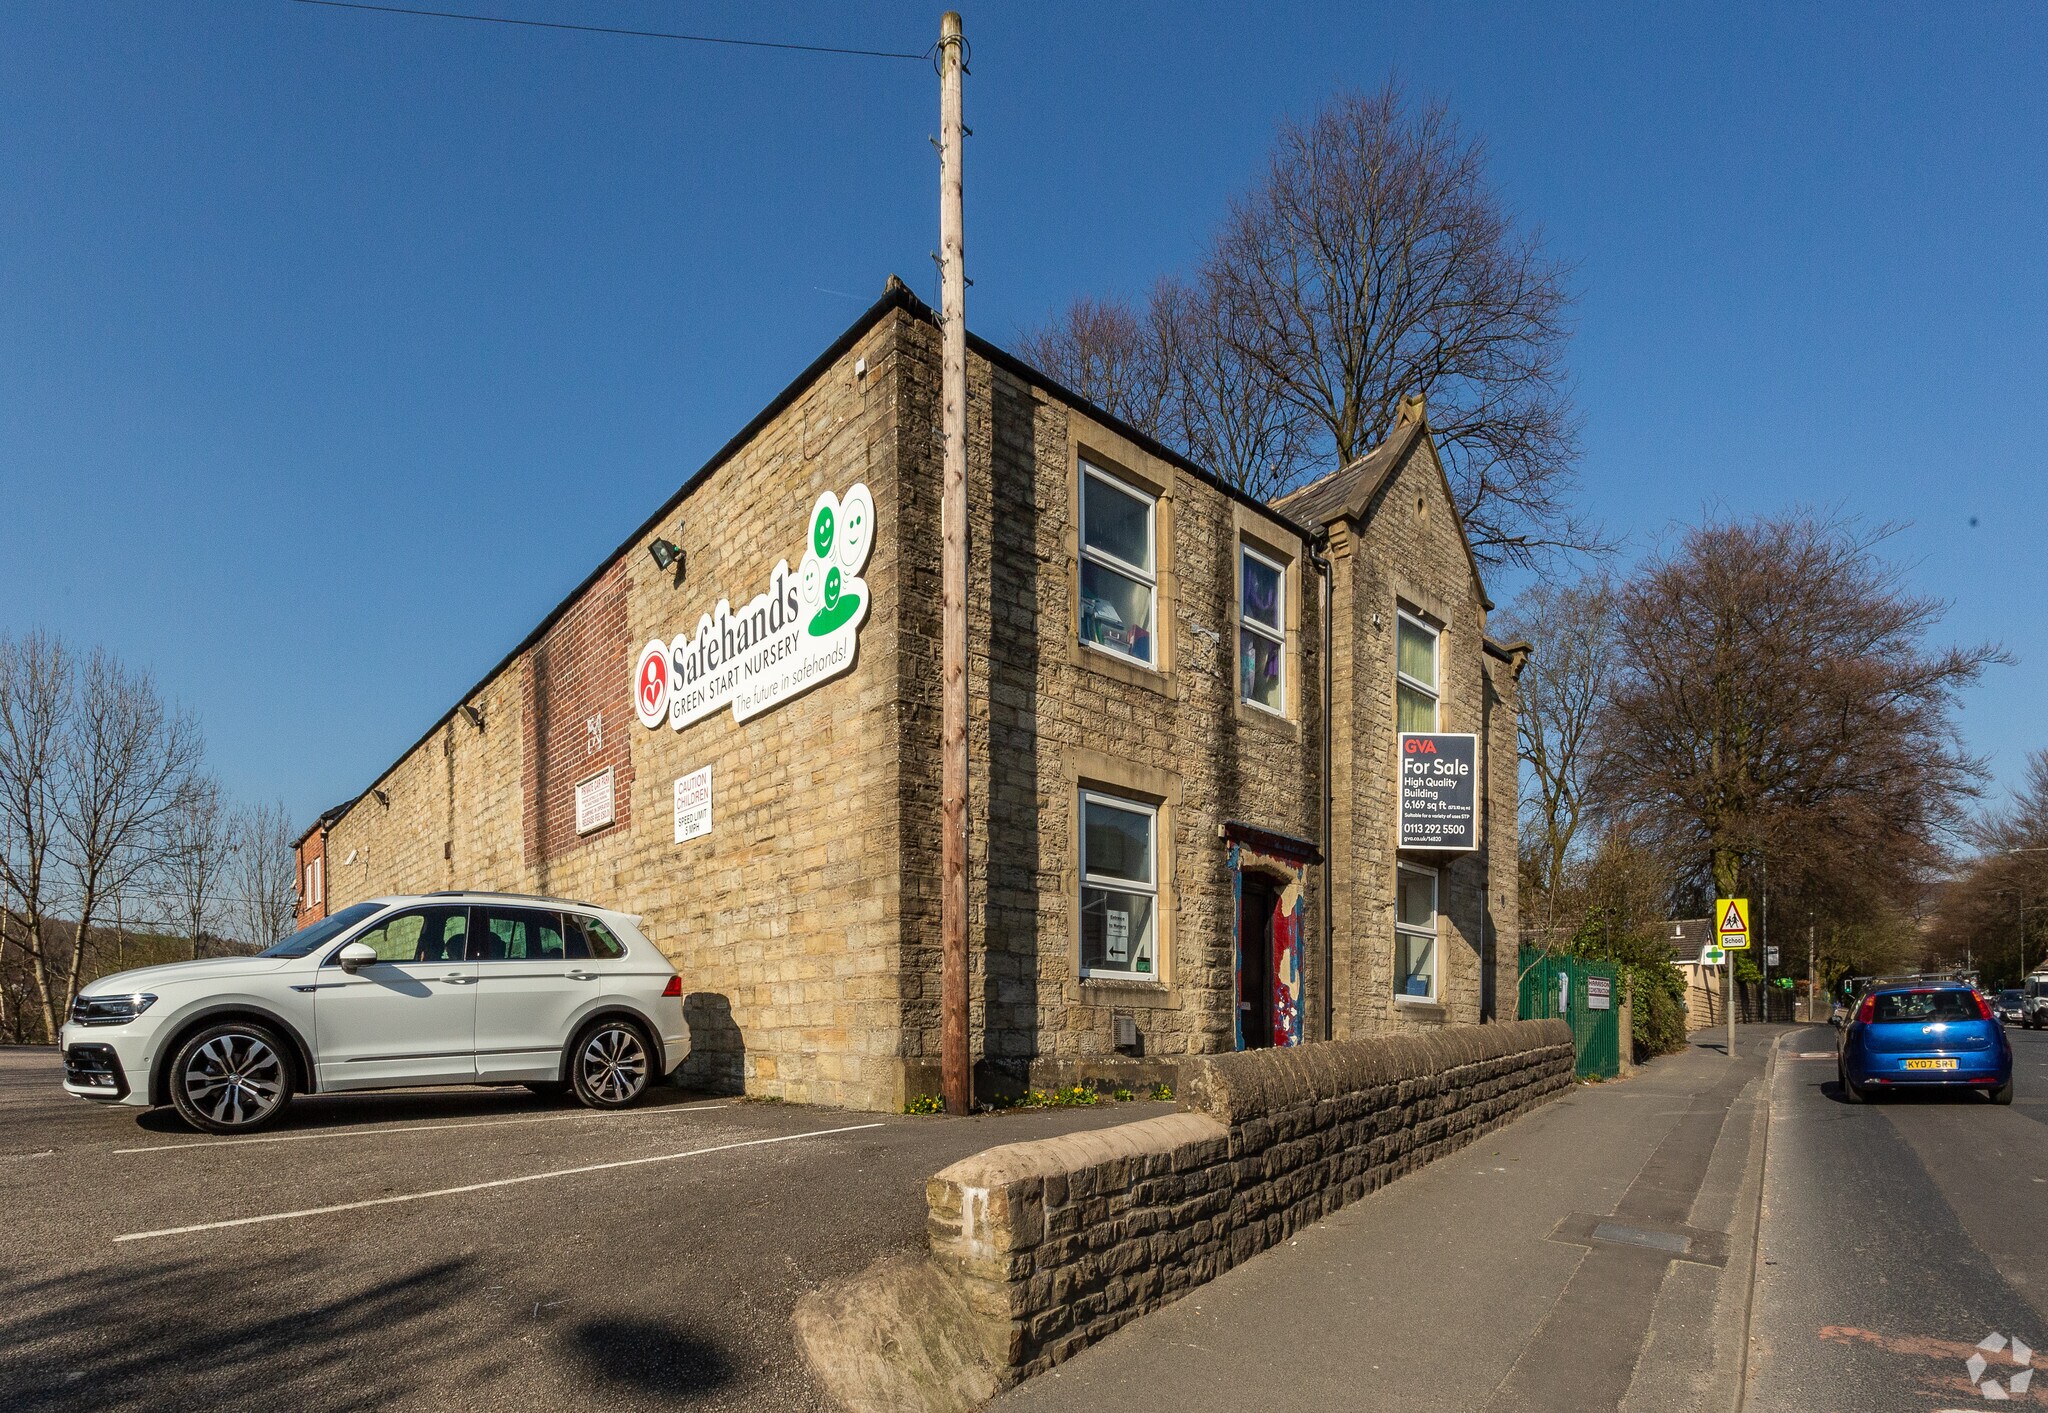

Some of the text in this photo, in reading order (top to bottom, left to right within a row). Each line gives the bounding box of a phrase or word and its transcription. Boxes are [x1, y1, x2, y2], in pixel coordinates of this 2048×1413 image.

[673, 574, 799, 691] Safehands
[673, 630, 800, 719] GREEN START NURSERY
[736, 637, 847, 713] The future in safehands!
[1405, 739, 1437, 754] GVA
[1404, 758, 1469, 775] For Sale
[678, 772, 706, 795] CAUTION
[1404, 777, 1457, 789] High Quality
[676, 787, 709, 810] CHILDREN
[1404, 789, 1438, 800] Building
[1404, 800, 1425, 810] 6,169
[1427, 802, 1437, 812] sq
[1439, 801, 1447, 809] ft
[678, 808, 707, 828] SPEED LIMIT
[689, 823, 700, 834] MPH
[1404, 823, 1465, 834] 0113 292 5500
[1907, 1060, 1932, 1068] KY07
